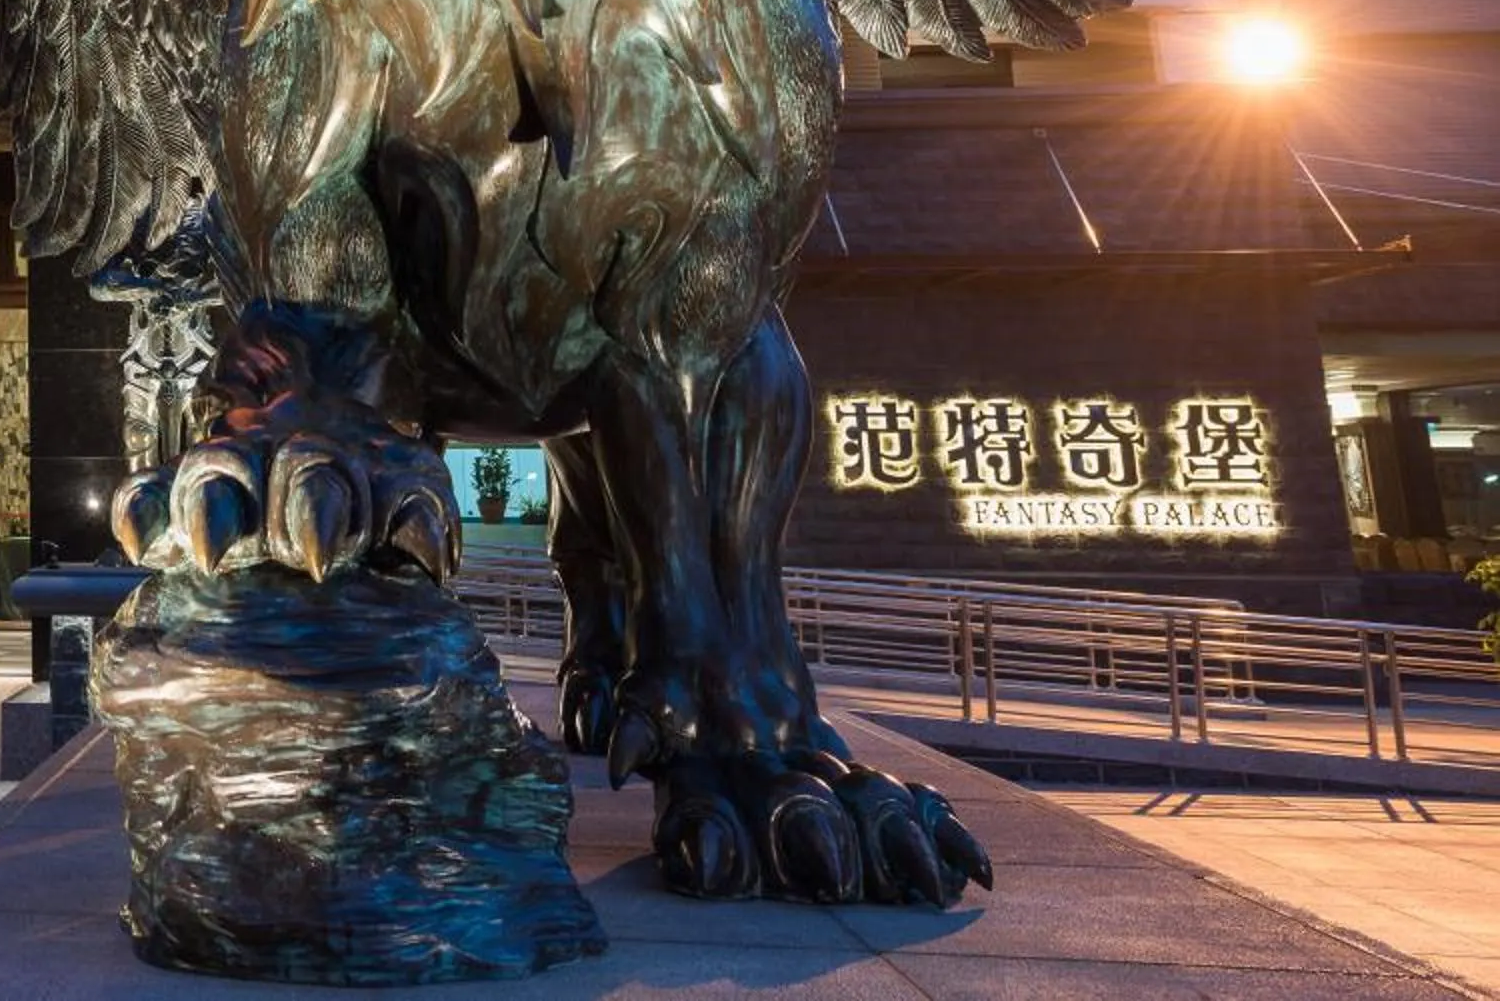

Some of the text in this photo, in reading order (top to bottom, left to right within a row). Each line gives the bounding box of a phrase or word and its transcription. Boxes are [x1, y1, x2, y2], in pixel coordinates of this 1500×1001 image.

[835, 401, 1269, 487] 范特奇堡
[974, 501, 1274, 527] FANTASY PALACE
